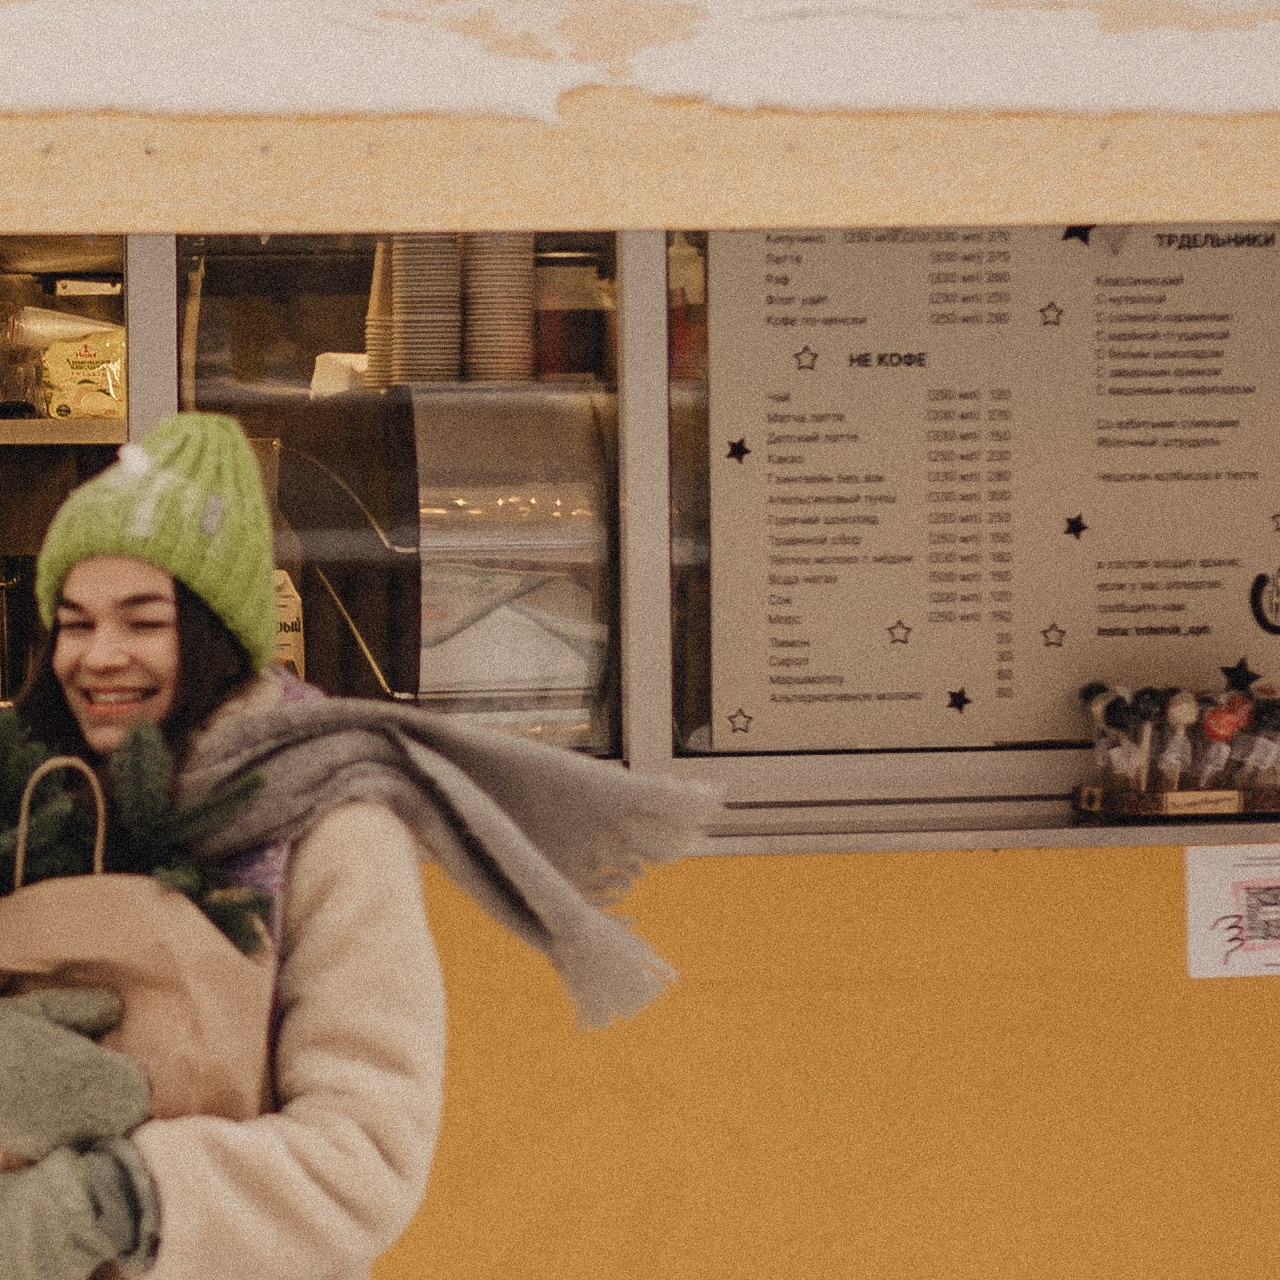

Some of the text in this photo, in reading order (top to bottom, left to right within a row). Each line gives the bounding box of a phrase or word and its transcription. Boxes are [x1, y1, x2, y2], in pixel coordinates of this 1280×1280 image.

[1155, 232, 1276, 250] ТРДЕЛЬНИКИ
[848, 352, 927, 368] НЕ КОФЕ
